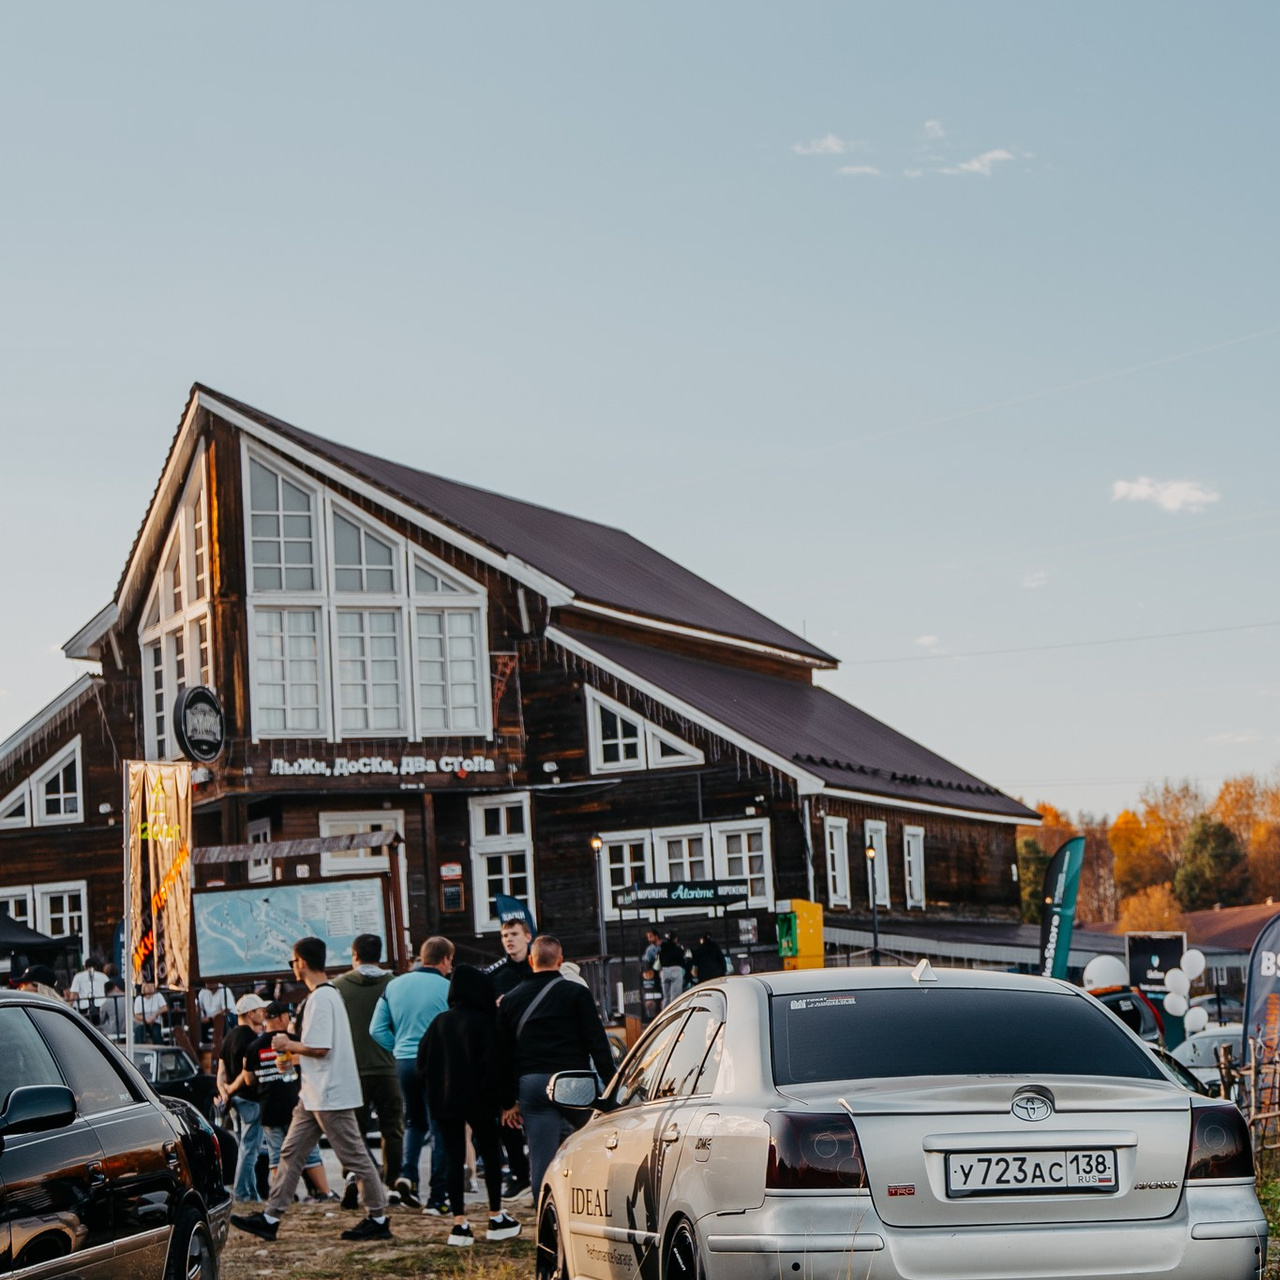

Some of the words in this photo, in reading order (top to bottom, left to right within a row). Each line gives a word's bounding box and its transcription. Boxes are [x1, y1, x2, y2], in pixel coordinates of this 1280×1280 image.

[1069, 1154, 1107, 1175] 138
[1078, 1175, 1098, 1183] RUS
[1134, 1180, 1179, 1190] AVENSIS
[571, 1187, 612, 1218] IDEAL
